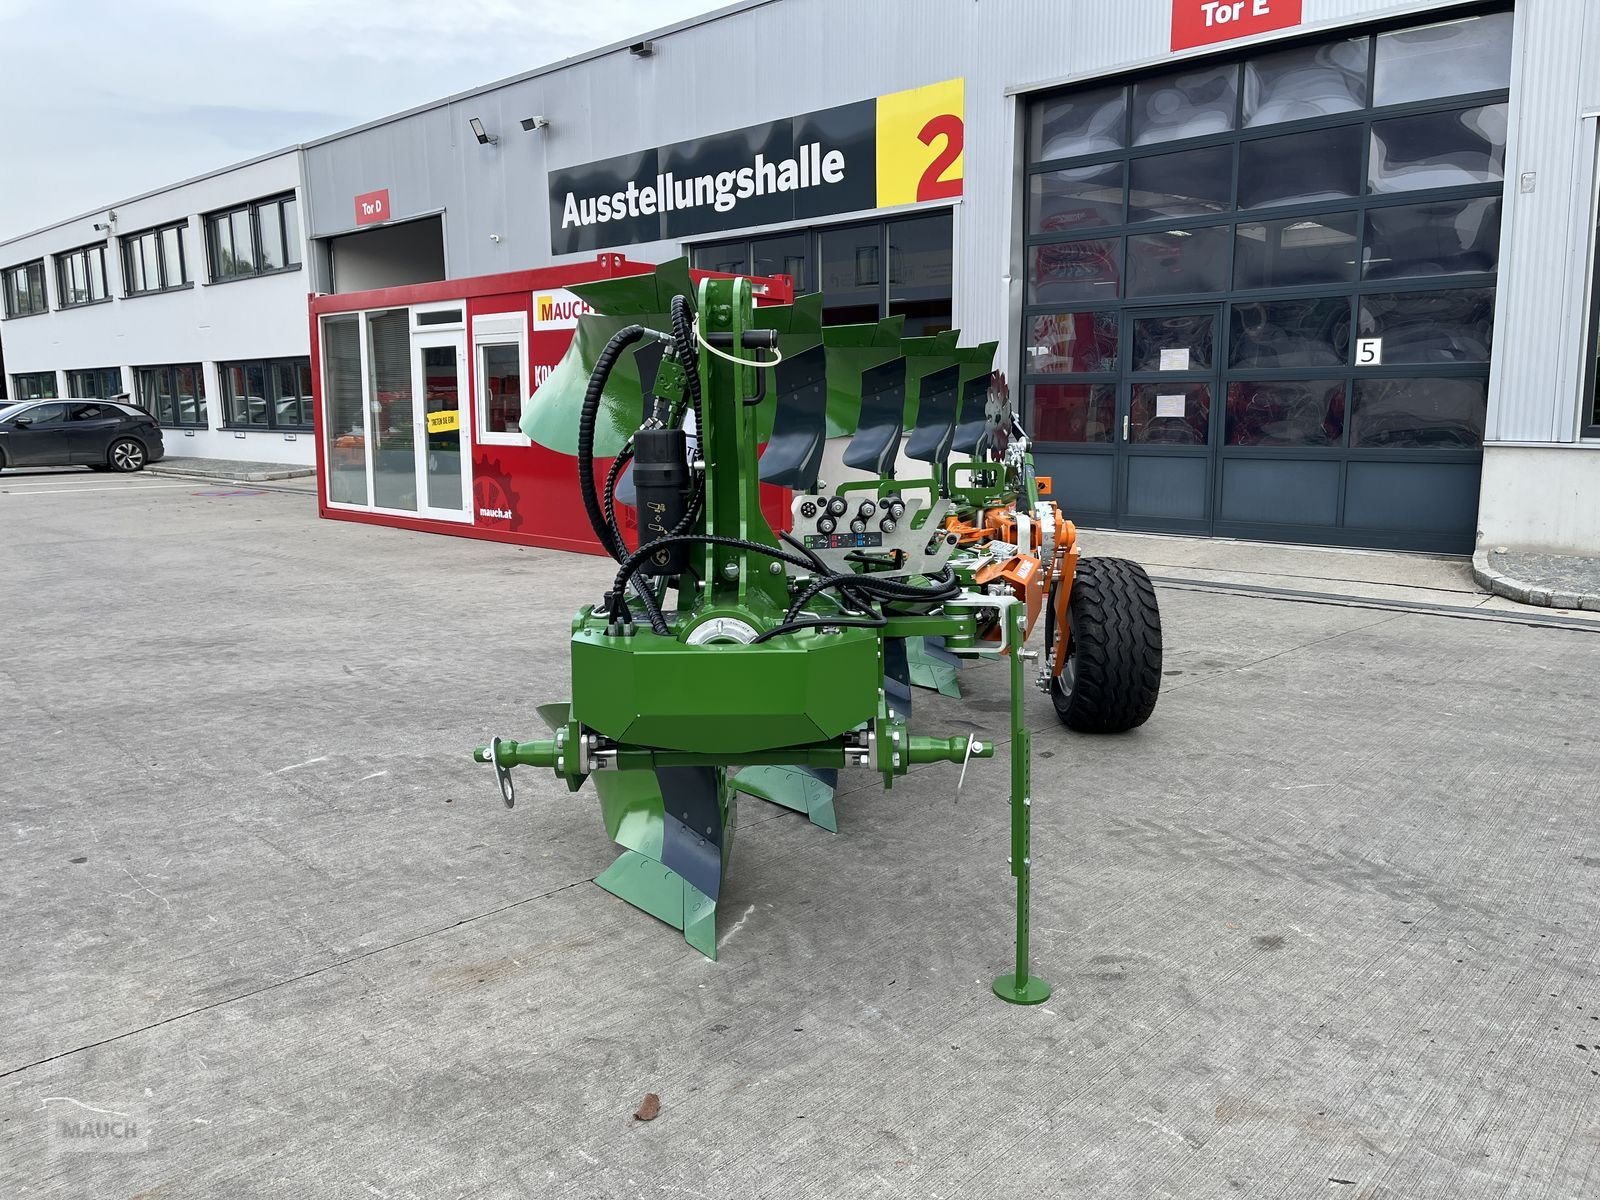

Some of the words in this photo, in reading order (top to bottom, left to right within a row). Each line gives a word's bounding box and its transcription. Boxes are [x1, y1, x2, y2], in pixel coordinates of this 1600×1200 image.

[1200, 1, 1245, 27] Tor
[1252, 0, 1270, 17] E
[561, 142, 846, 229] Ausstellungshalle
[916, 113, 964, 203] 2
[361, 202, 375, 216] Tor
[375, 199, 382, 213] D
[541, 301, 590, 321] MAUCH
[1361, 342, 1375, 363] 5
[479, 507, 513, 520] mauch.at
